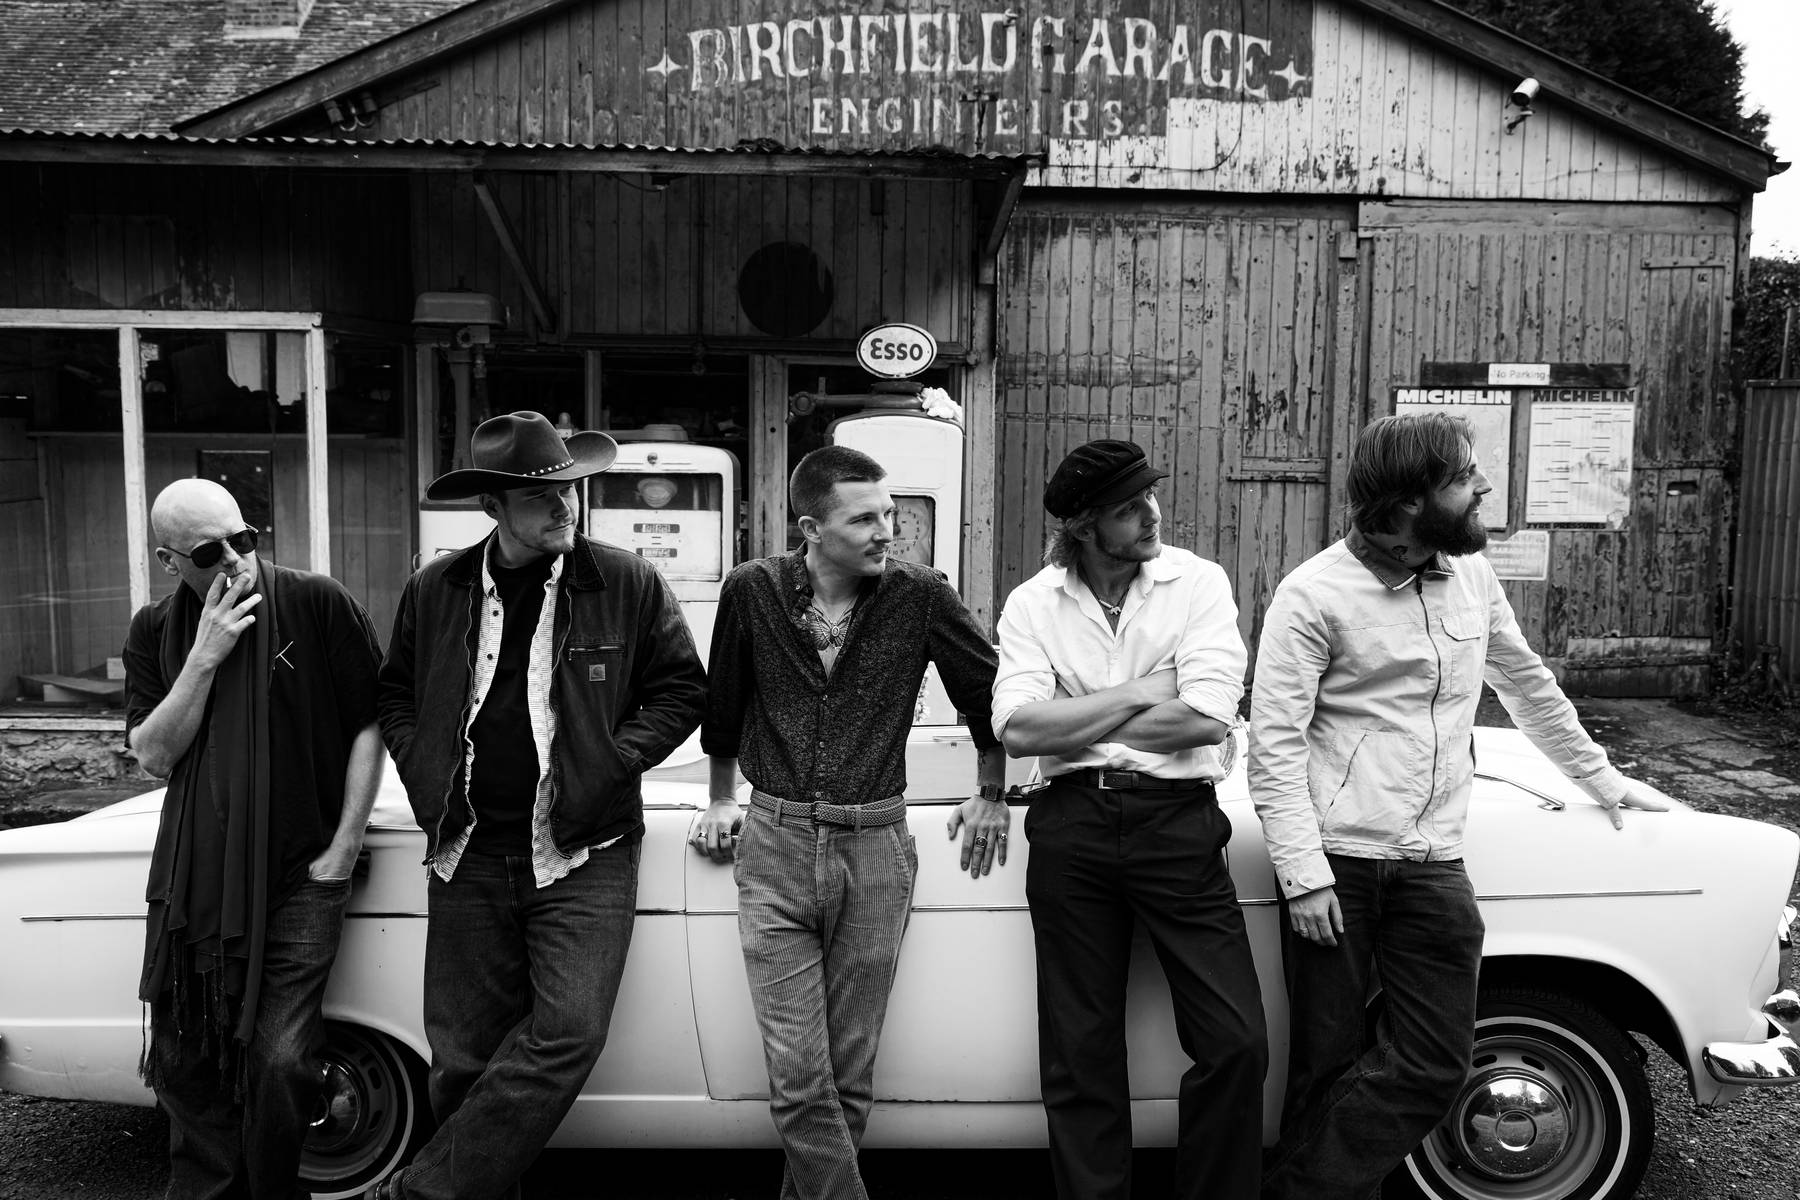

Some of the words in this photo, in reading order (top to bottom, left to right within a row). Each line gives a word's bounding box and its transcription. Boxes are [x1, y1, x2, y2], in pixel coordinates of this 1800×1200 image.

[687, 12, 1017, 92] BIRCHFIELD
[1031, 16, 1272, 100] GARAGE
[1396, 389, 1512, 404] MICHELIN
[1532, 389, 1635, 403] MICHELIN
